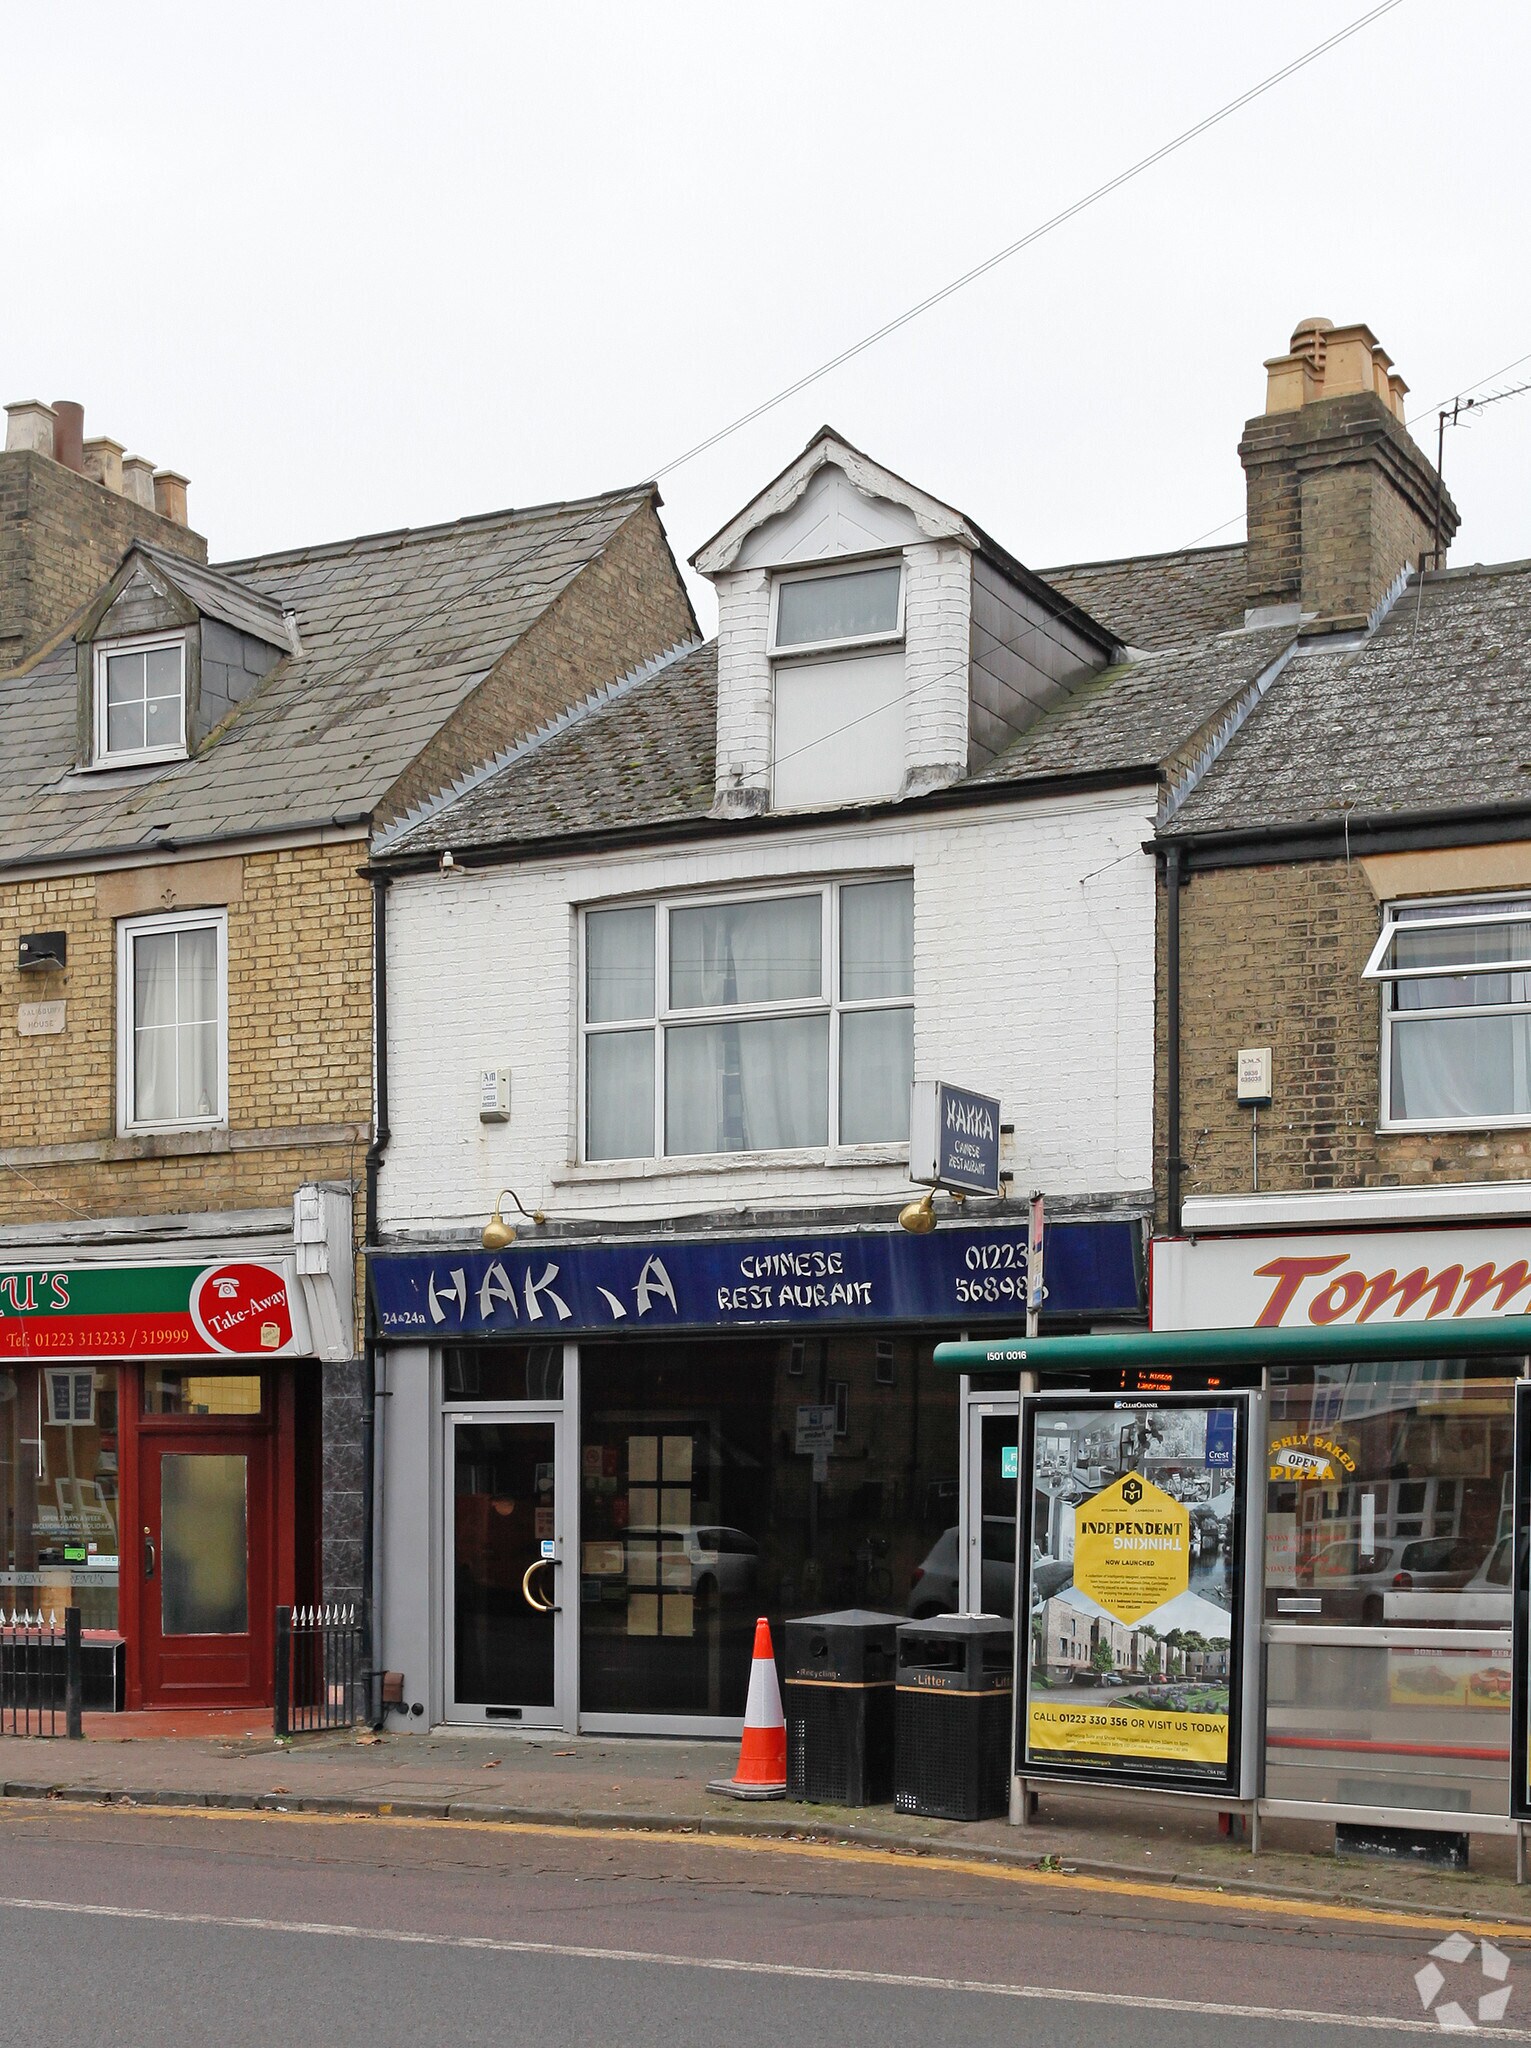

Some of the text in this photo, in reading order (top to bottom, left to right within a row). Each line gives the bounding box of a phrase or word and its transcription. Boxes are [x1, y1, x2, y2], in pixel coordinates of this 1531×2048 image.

[946, 1095, 994, 1142] HAKKA
[954, 1140, 980, 1158] CHINESE
[948, 1154, 986, 1175] RESTAURANT
[740, 1251, 844, 1278] CHINESE
[965, 1242, 1028, 1270] 01223
[0, 1272, 70, 1317] U'S
[718, 1282, 872, 1310] RESTAURANT
[208, 1289, 286, 1334] Take-Away
[6, 1331, 30, 1347] Tel:
[35, 1332, 74, 1347] 01223
[78, 1330, 126, 1346] 313233
[140, 1328, 189, 1344] 319999
[1208, 1450, 1230, 1460] Crest
[1268, 1434, 1356, 1473] SHLY BAKED
[1288, 1454, 1318, 1468] OPEN
[1269, 1466, 1336, 1480] PIZZA
[1081, 1522, 1182, 1536] INDEPENDENT
[1114, 1536, 1182, 1550] THINKING
[800, 1668, 837, 1680] Recycling
[917, 1674, 946, 1686] Litter
[1034, 1712, 1226, 1734] CALL 01223 330 356 OR VISIT US TODAY
